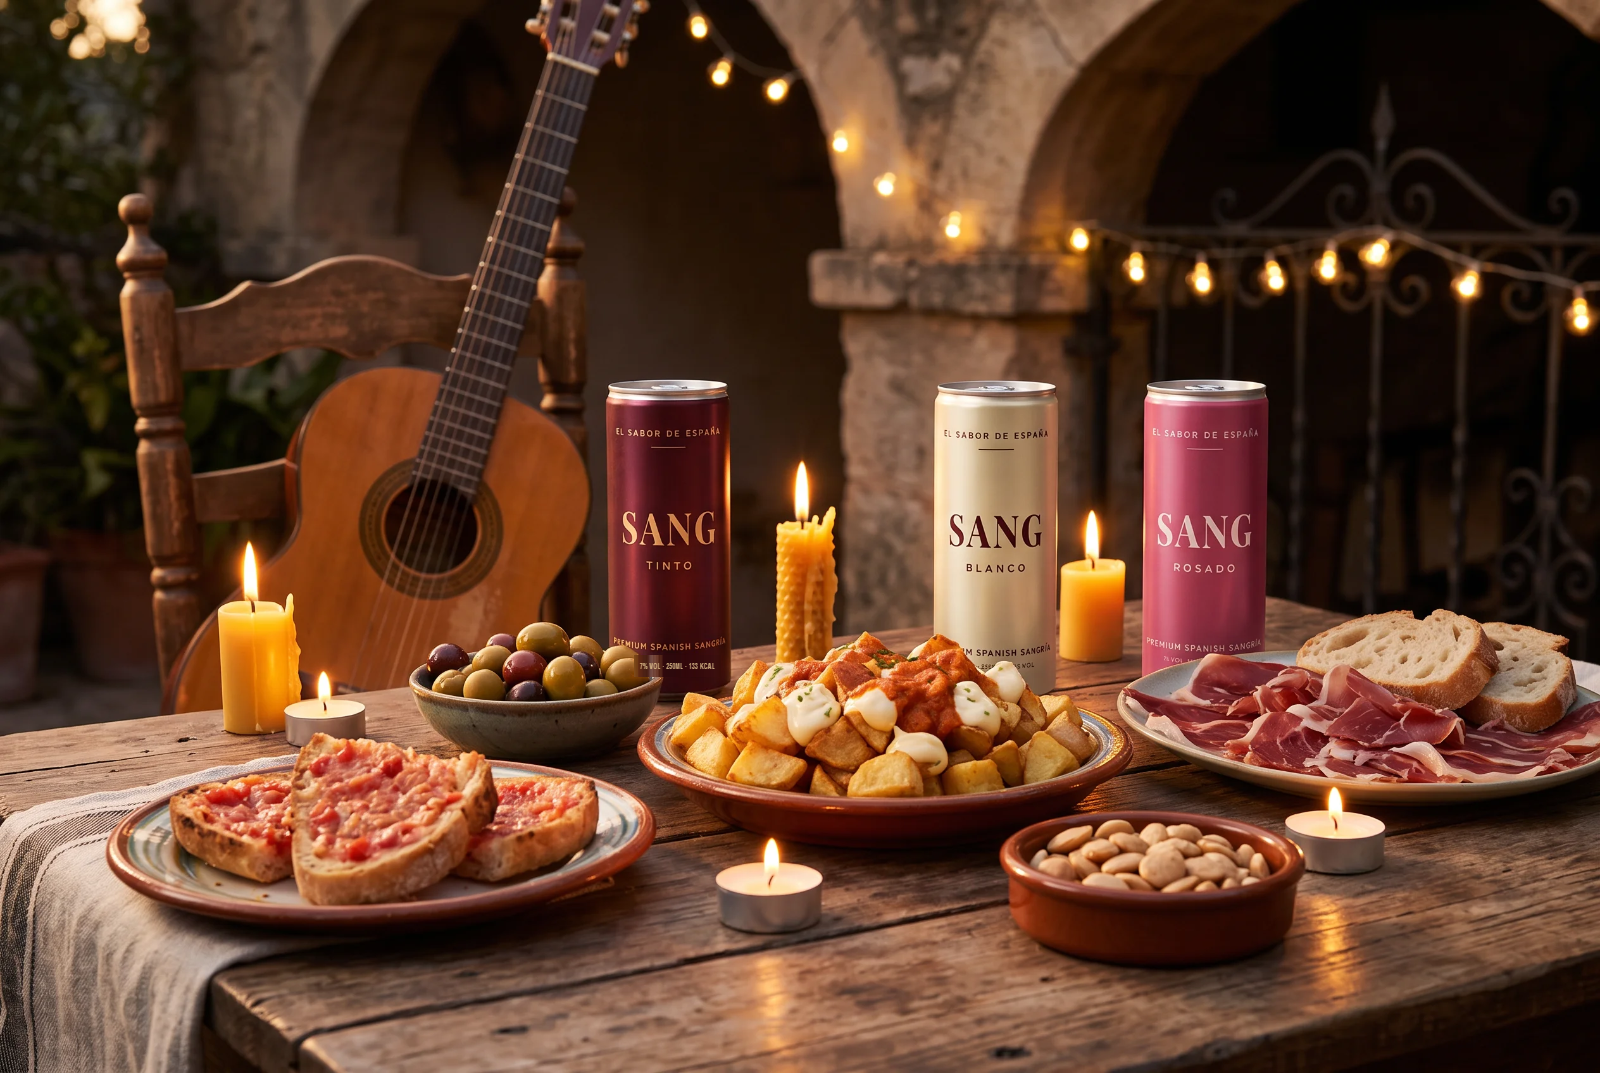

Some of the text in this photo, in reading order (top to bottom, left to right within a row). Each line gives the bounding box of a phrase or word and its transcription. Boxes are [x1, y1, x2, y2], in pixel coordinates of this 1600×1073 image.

[615, 425, 721, 438] EL SABOR DE ESPAÑA
[943, 428, 1049, 440] EL SABOR DE ESPAÑA
[1152, 427, 1259, 439] EL SABOR DE ESPAÑA
[622, 510, 716, 547] SANG
[949, 513, 1043, 549] SANG
[1157, 512, 1252, 549] SANG
[645, 560, 692, 571] TINTO
[966, 563, 1026, 573] BLANCO
[1173, 562, 1236, 574] ROSADO
[650, 643, 691, 651] SPANISH
[976, 648, 1017, 657] SPANISH
[1020, 642, 1051, 656] SANGRÍA
[1146, 636, 1181, 651] PREMIUM
[1184, 643, 1225, 653] SPANISH
[639, 662, 716, 670] 7% VOL 250ML 133 KCAL
